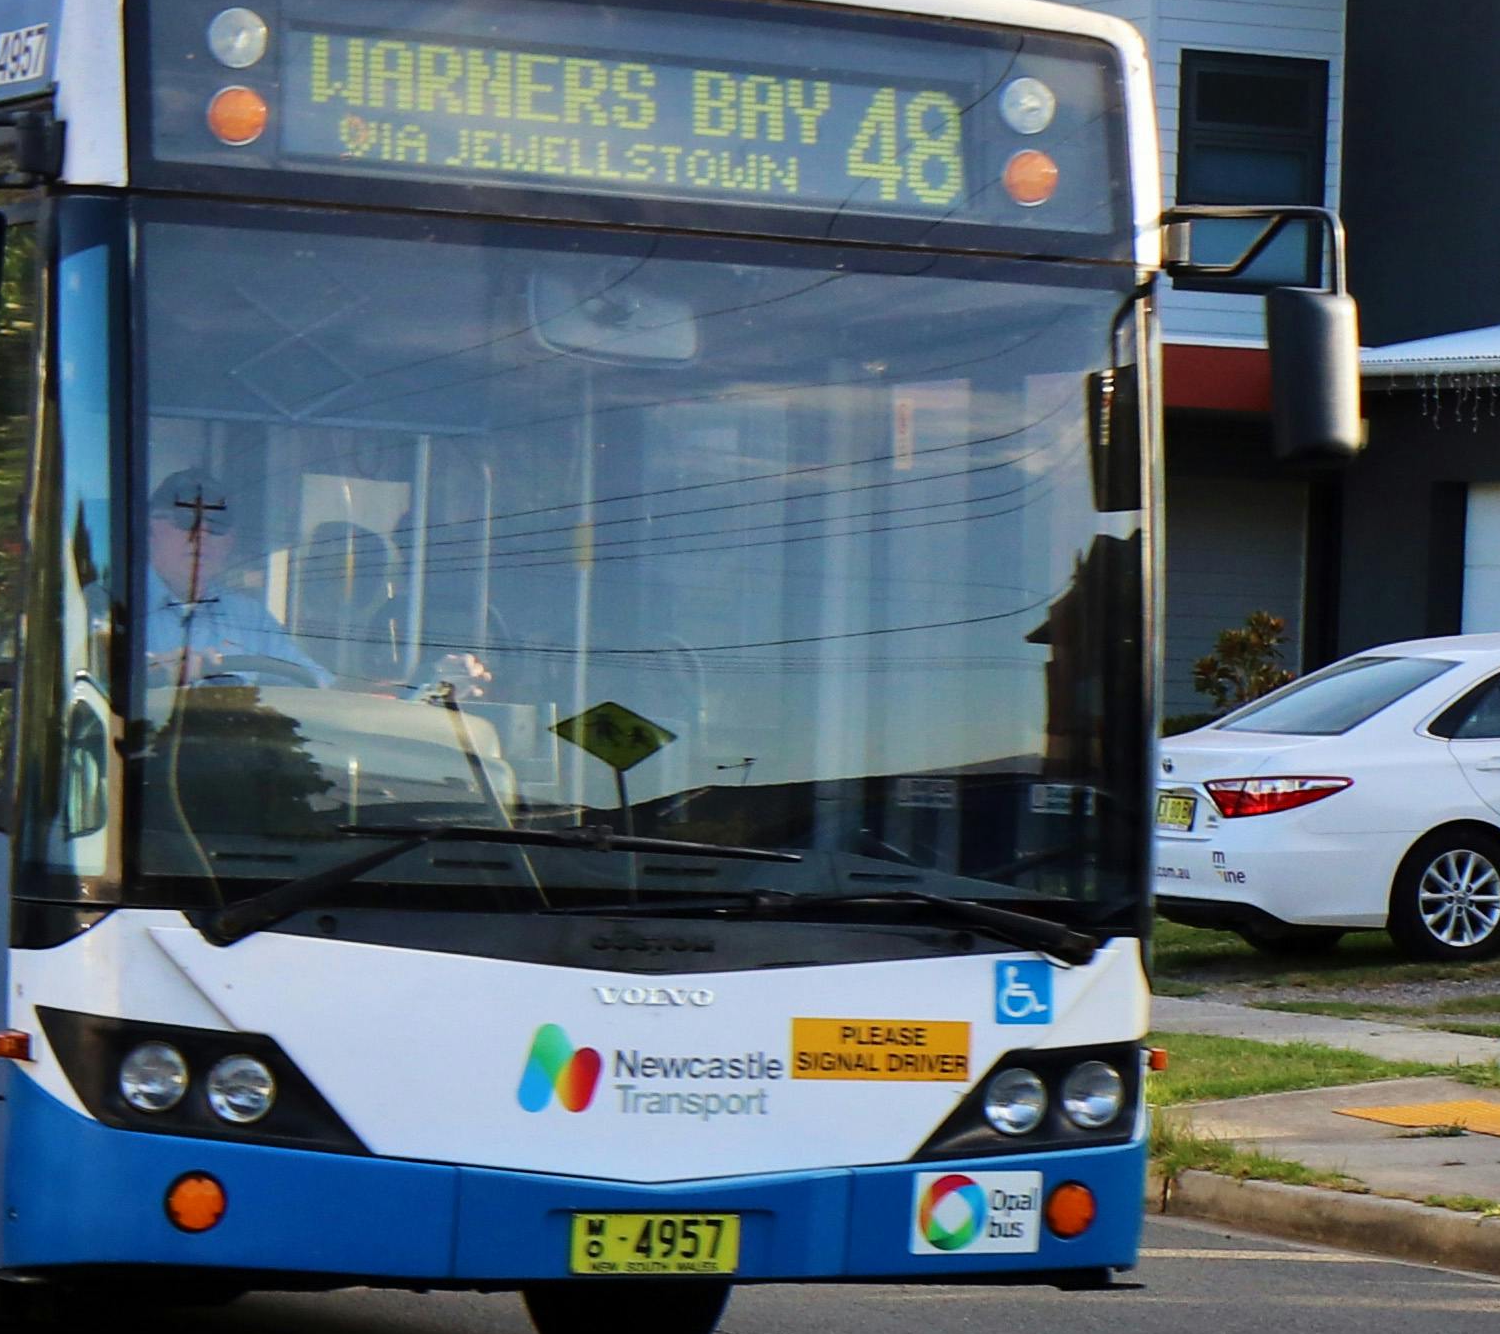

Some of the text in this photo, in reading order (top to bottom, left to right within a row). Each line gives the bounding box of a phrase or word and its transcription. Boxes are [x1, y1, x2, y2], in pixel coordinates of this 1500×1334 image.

[310, 34, 964, 205] WARNERS BAY 48
[340, 116, 799, 194] VIA JEWELLSTOWN
[591, 985, 717, 1007] VOLVO
[840, 1026, 928, 1047] PLEASE
[613, 1049, 784, 1080] Newcastle
[796, 1051, 969, 1074] SIGNAL DRIVER
[614, 1084, 768, 1120] Transport
[989, 1187, 1038, 1213] Opal
[989, 1218, 1025, 1240] bus
[590, 1261, 719, 1272] NEW SOUTH WALES
